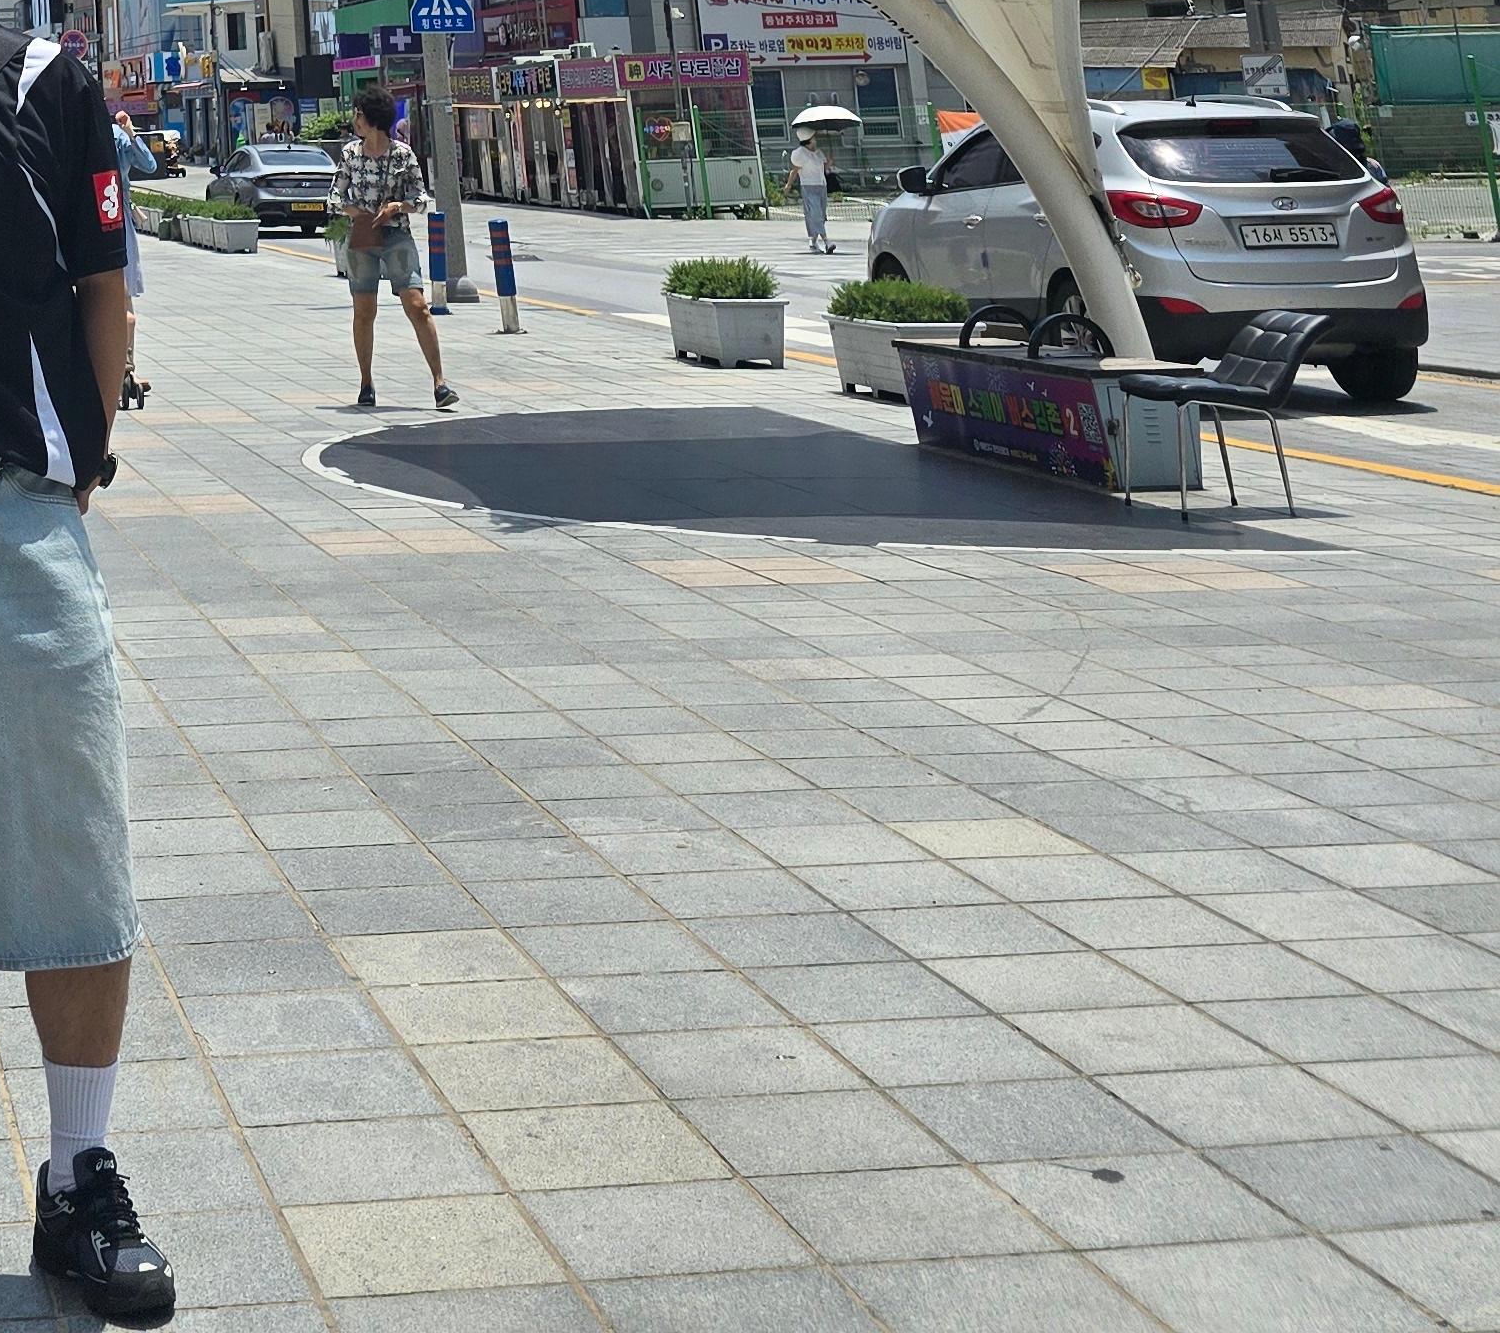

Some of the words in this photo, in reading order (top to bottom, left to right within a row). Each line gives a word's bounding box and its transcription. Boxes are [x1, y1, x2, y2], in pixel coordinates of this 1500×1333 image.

[421, 18, 465, 30] 횡단보도
[759, 39, 786, 54] 바로옆
[835, 37, 865, 51] 주차장
[680, 58, 711, 78] 타로
[724, 57, 742, 77] 샵
[1252, 226, 1284, 243] 16서
[1289, 226, 1328, 243] 5513
[1006, 394, 1065, 437] 버스킹존
[1065, 408, 1079, 437] 2
